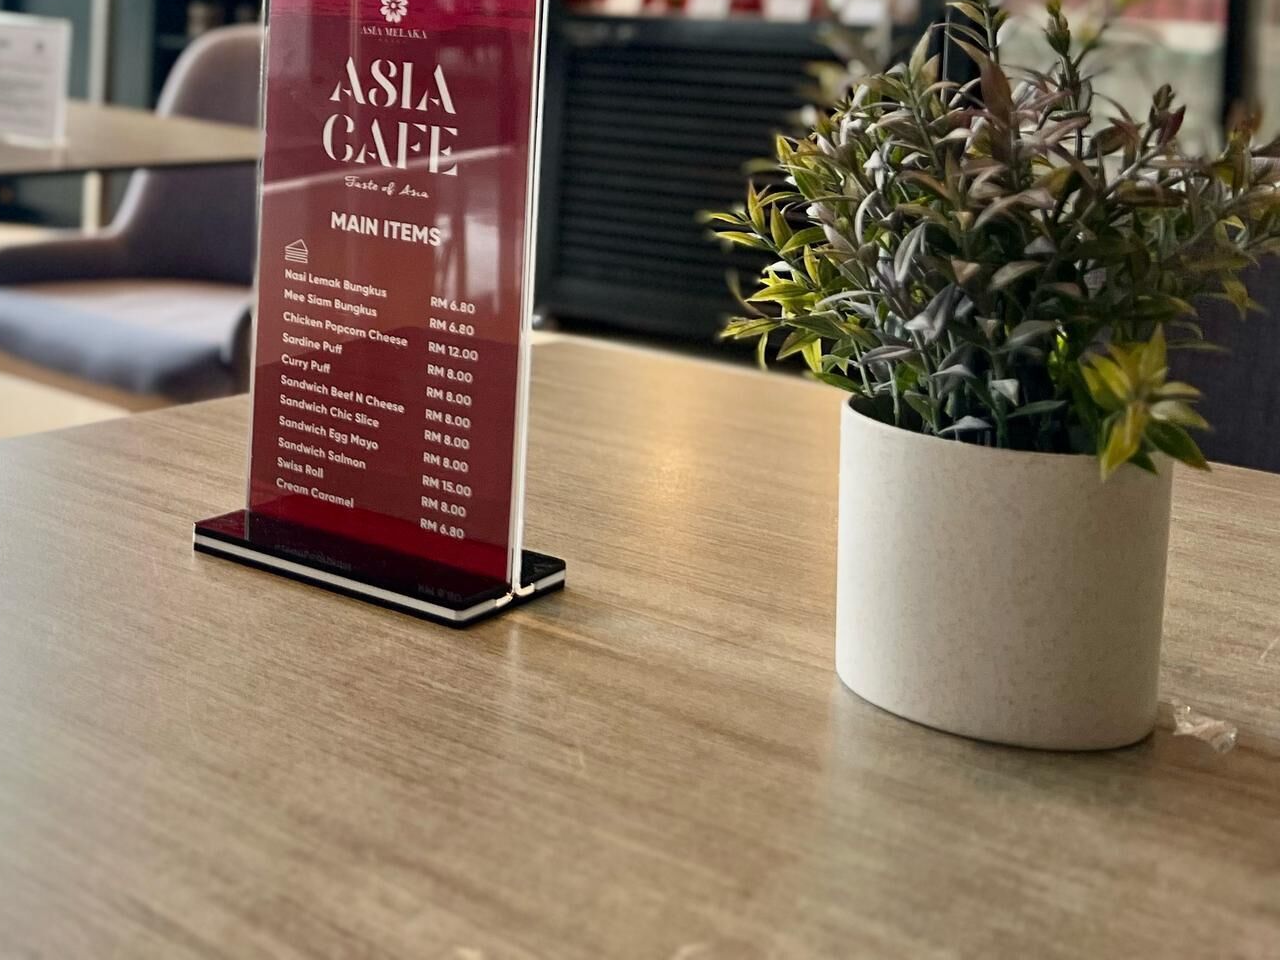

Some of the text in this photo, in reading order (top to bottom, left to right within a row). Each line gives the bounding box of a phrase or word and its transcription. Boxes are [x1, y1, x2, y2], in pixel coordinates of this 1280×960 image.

[360, 26, 428, 39] ASIA MELAKA
[329, 56, 456, 114] ASIA
[322, 114, 458, 176] CAFE
[344, 176, 429, 199] Taste of Asia
[331, 212, 442, 246] MAIN ITEMS
[284, 289, 474, 336] Mee Siam Bungkus RM 6.80
[285, 269, 475, 314] Nasi Lemak Bungkus RM 6.80
[283, 312, 478, 361] Chicken Popcorn Cheese RM 12.00
[283, 332, 473, 383] Sardine Puff RM 8.00
[281, 375, 470, 428] Sandwich Beef N Cheese RM 8.00
[282, 354, 472, 406] Curry Puff RM 8.00
[279, 416, 469, 473] Sandwich Egg Mayo RM 8.00
[280, 394, 469, 449] Sandwich Chic Slice RM 8.00
[277, 457, 466, 517] Swiss Roll RM 8.00
[278, 437, 472, 497] Sandwich Salmon RM 15.00
[276, 478, 464, 539] Cream Caramel RM 6.80
